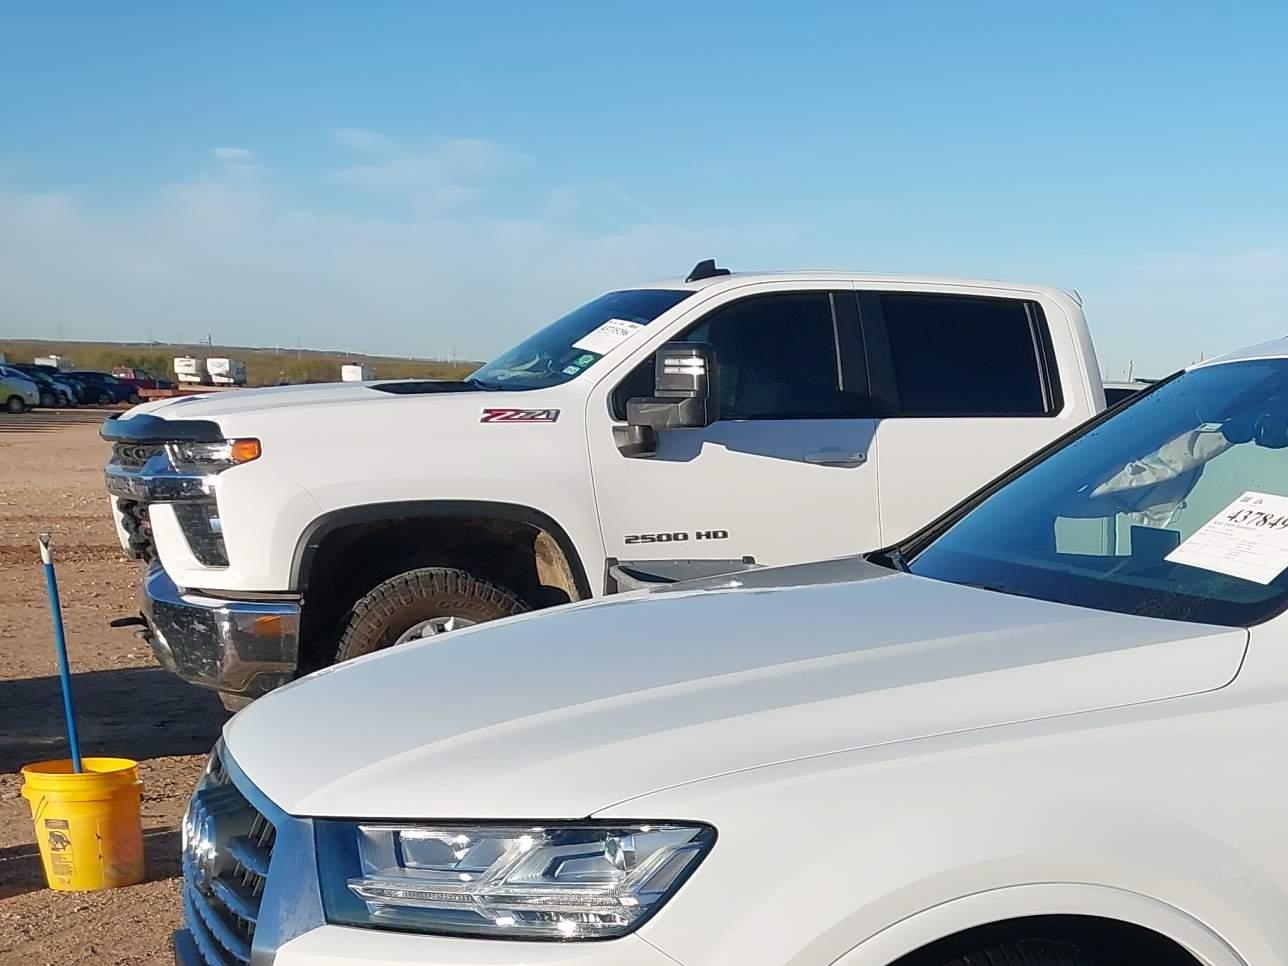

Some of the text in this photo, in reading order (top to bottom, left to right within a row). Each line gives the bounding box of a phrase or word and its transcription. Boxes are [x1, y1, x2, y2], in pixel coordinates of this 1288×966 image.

[480, 408, 560, 422] Z71
[624, 530, 729, 544] 2500 HD
